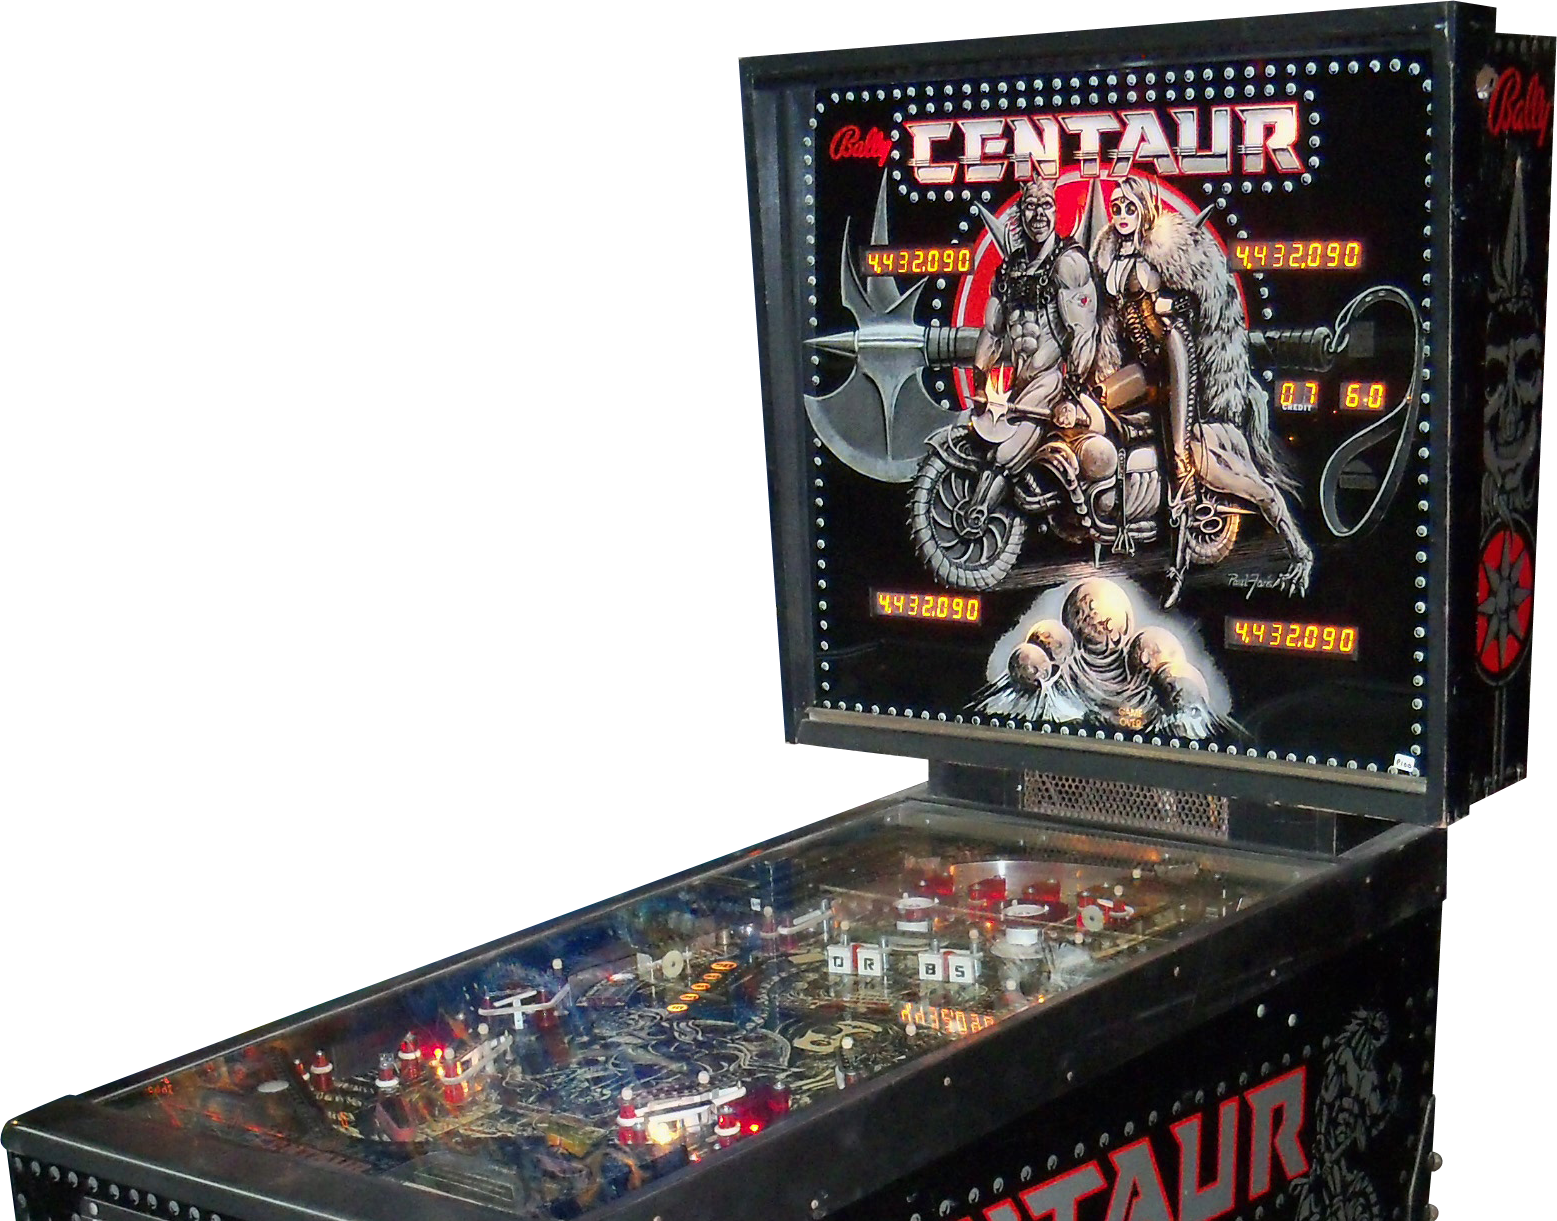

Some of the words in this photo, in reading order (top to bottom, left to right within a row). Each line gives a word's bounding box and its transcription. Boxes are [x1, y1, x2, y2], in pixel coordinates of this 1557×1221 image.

[1488, 66, 1551, 148] Bally
[829, 125, 893, 167] Bally
[903, 101, 1305, 183] CENTAUR
[1282, 404, 1312, 412] CREDIT
[1119, 708, 1142, 718] GAME
[1119, 718, 1142, 728] OVER
